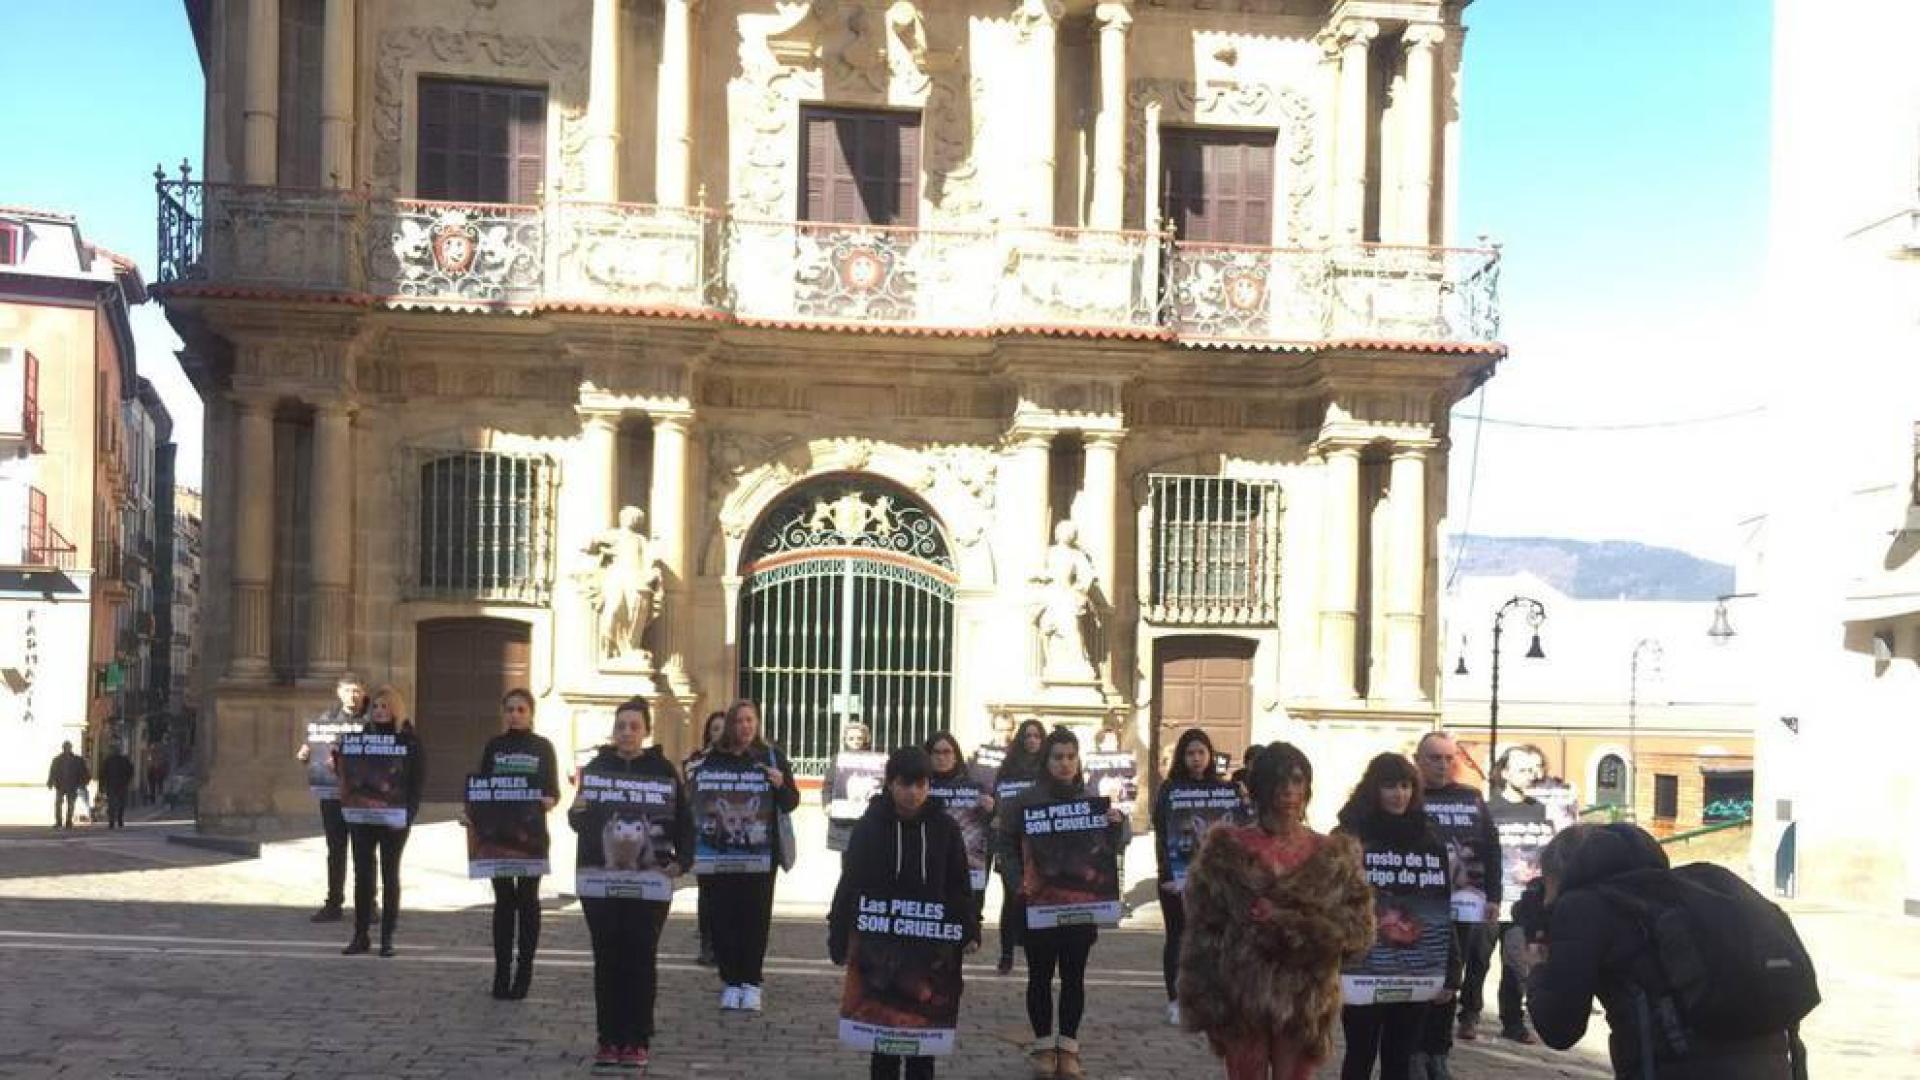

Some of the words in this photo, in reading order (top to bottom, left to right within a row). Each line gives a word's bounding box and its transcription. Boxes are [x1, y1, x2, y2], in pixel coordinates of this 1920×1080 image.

[469, 776, 489, 788] Las
[490, 776, 528, 788] PIELES
[1024, 809, 1046, 820] Las
[1048, 802, 1090, 818] PIELES
[1025, 820, 1051, 834] SON
[1055, 815, 1110, 831] CRUELES
[1366, 851, 1403, 866] resto
[1405, 852, 1423, 867] de
[1425, 853, 1440, 868] tu
[1366, 866, 1395, 886] rigo
[1397, 868, 1417, 884] de
[1419, 869, 1446, 888] piel
[859, 895, 887, 914] Las
[891, 899, 945, 919] PIELES
[857, 914, 889, 933] SON
[893, 918, 963, 940] CRUELES
